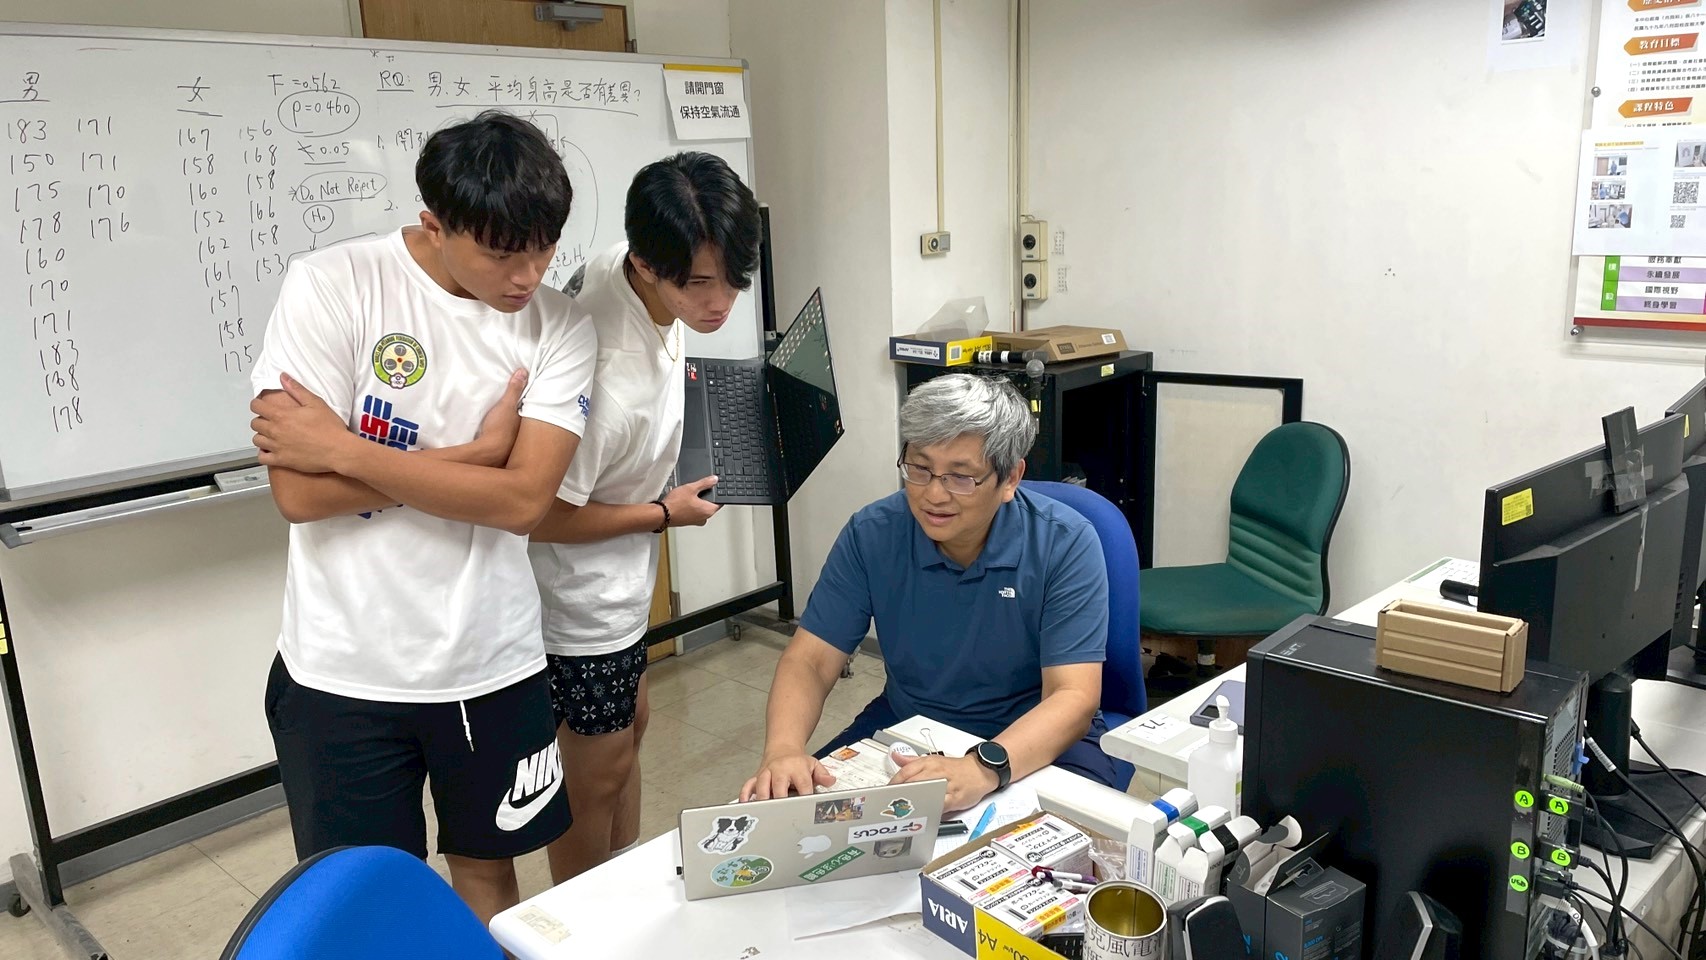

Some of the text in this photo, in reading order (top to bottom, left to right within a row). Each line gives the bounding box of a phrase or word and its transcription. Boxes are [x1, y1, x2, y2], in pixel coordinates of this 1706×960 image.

[1639, 37, 1680, 50] 教育目標
[23, 71, 40, 100] 男
[177, 76, 211, 102] 女
[685, 81, 724, 96] 請開門窗
[679, 105, 741, 120] 保持空氣流通
[1633, 101, 1675, 112] 課程特色
[8, 118, 47, 143] 183
[77, 116, 111, 135] 171
[239, 119, 272, 140] 156
[178, 128, 210, 151] 167
[10, 153, 54, 175] 150
[82, 152, 116, 171] 171
[183, 153, 214, 175] 158
[243, 145, 277, 166] 168
[247, 169, 275, 194] 158
[320, 181, 340, 199] Not
[15, 181, 60, 212] 175
[89, 184, 125, 208] 170
[189, 182, 217, 205] 160
[250, 196, 275, 223] 166
[20, 212, 61, 243] 178
[91, 212, 129, 241] 176
[194, 210, 225, 233] 152
[250, 225, 279, 251] 158
[26, 248, 65, 274] 160
[198, 238, 230, 263] 162
[204, 260, 231, 287] 161
[256, 253, 284, 281] 153
[1646, 271, 1680, 279] 永續發展
[29, 280, 68, 306] 170
[1645, 286, 1679, 295] 國際視野
[1644, 301, 1677, 309] 終身學習
[33, 310, 71, 339] 171
[223, 345, 252, 372] 175
[53, 396, 82, 432] 178
[511, 735, 562, 802] NIK
[1520, 794, 1529, 805] A
[1555, 801, 1565, 812] A
[853, 826, 898, 839] FOCUS
[1517, 845, 1526, 855] B
[1557, 852, 1566, 862] B
[1510, 878, 1526, 887] USB
[928, 897, 968, 934] ARIA
[978, 929, 997, 951] A4
